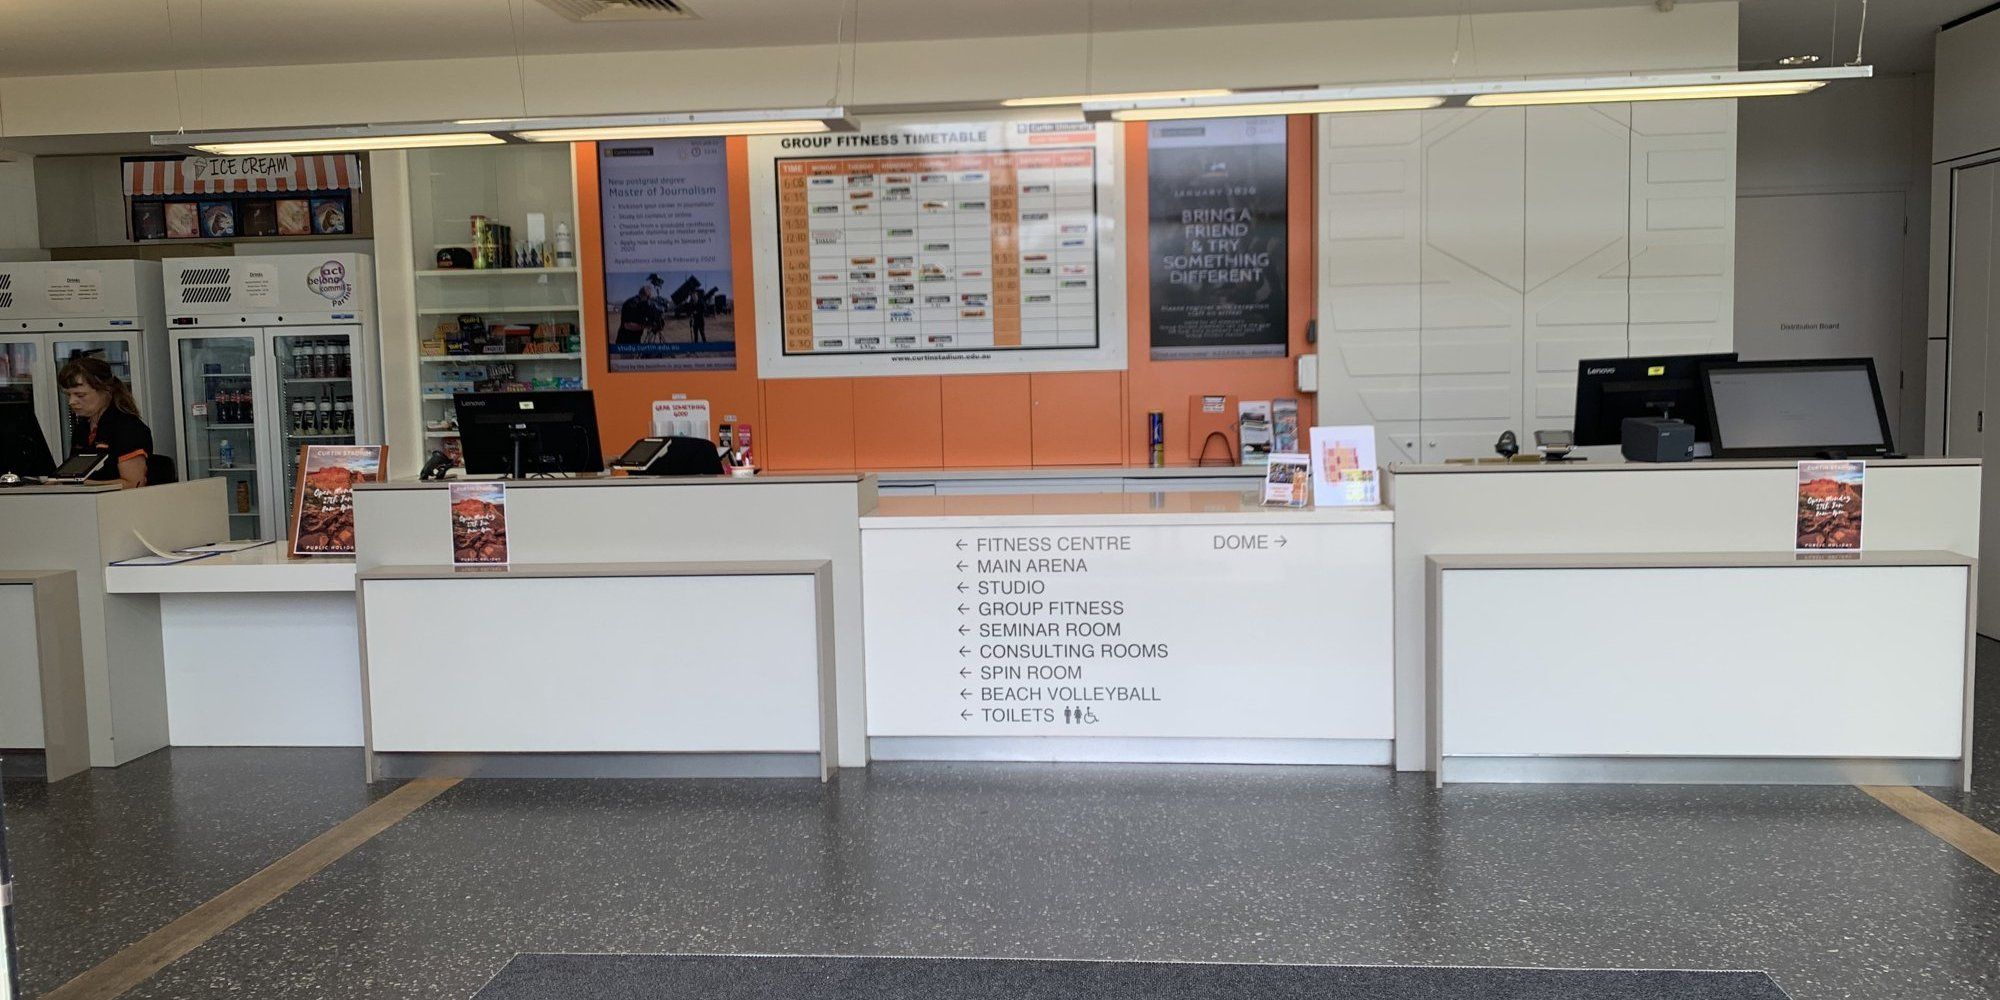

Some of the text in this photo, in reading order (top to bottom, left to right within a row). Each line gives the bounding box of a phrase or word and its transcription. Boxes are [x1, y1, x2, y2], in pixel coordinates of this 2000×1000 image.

[780, 131, 987, 149] GROUP FITNESS TIMETABLE
[210, 156, 288, 176] ICE CREAM
[784, 164, 803, 172] TIME
[609, 186, 716, 197] Master of Journalism
[1182, 208, 1252, 223] BRING A
[1184, 224, 1248, 238] FRIEND
[1192, 238, 1241, 253] & TRY
[1162, 252, 1270, 270] SOMETHING
[322, 266, 344, 276] act
[1170, 268, 1264, 284] DIFFERENT
[1780, 322, 1840, 331] Distribution Board
[891, 353, 992, 362] www.curtinstadium.edu.au
[1586, 366, 1616, 375] Lenovo
[342, 448, 372, 456] STADIUM
[314, 488, 332, 498] Open
[1807, 494, 1851, 506] Open Monday
[977, 536, 1130, 552] FITNESS CENTRE
[1214, 534, 1268, 550] DOME
[978, 558, 1088, 574] MAIN ARENA
[978, 580, 1046, 595] STUDIO
[979, 600, 1124, 616] GROUP FITNESS
[980, 622, 1120, 638] SEMINAR ROOM
[980, 644, 1168, 659] CONSULTING ROOMS
[981, 666, 1082, 680] SPIN ROOM
[982, 686, 1161, 702] BEACH VOLLEYBALL
[982, 708, 1054, 723] TOILETS
